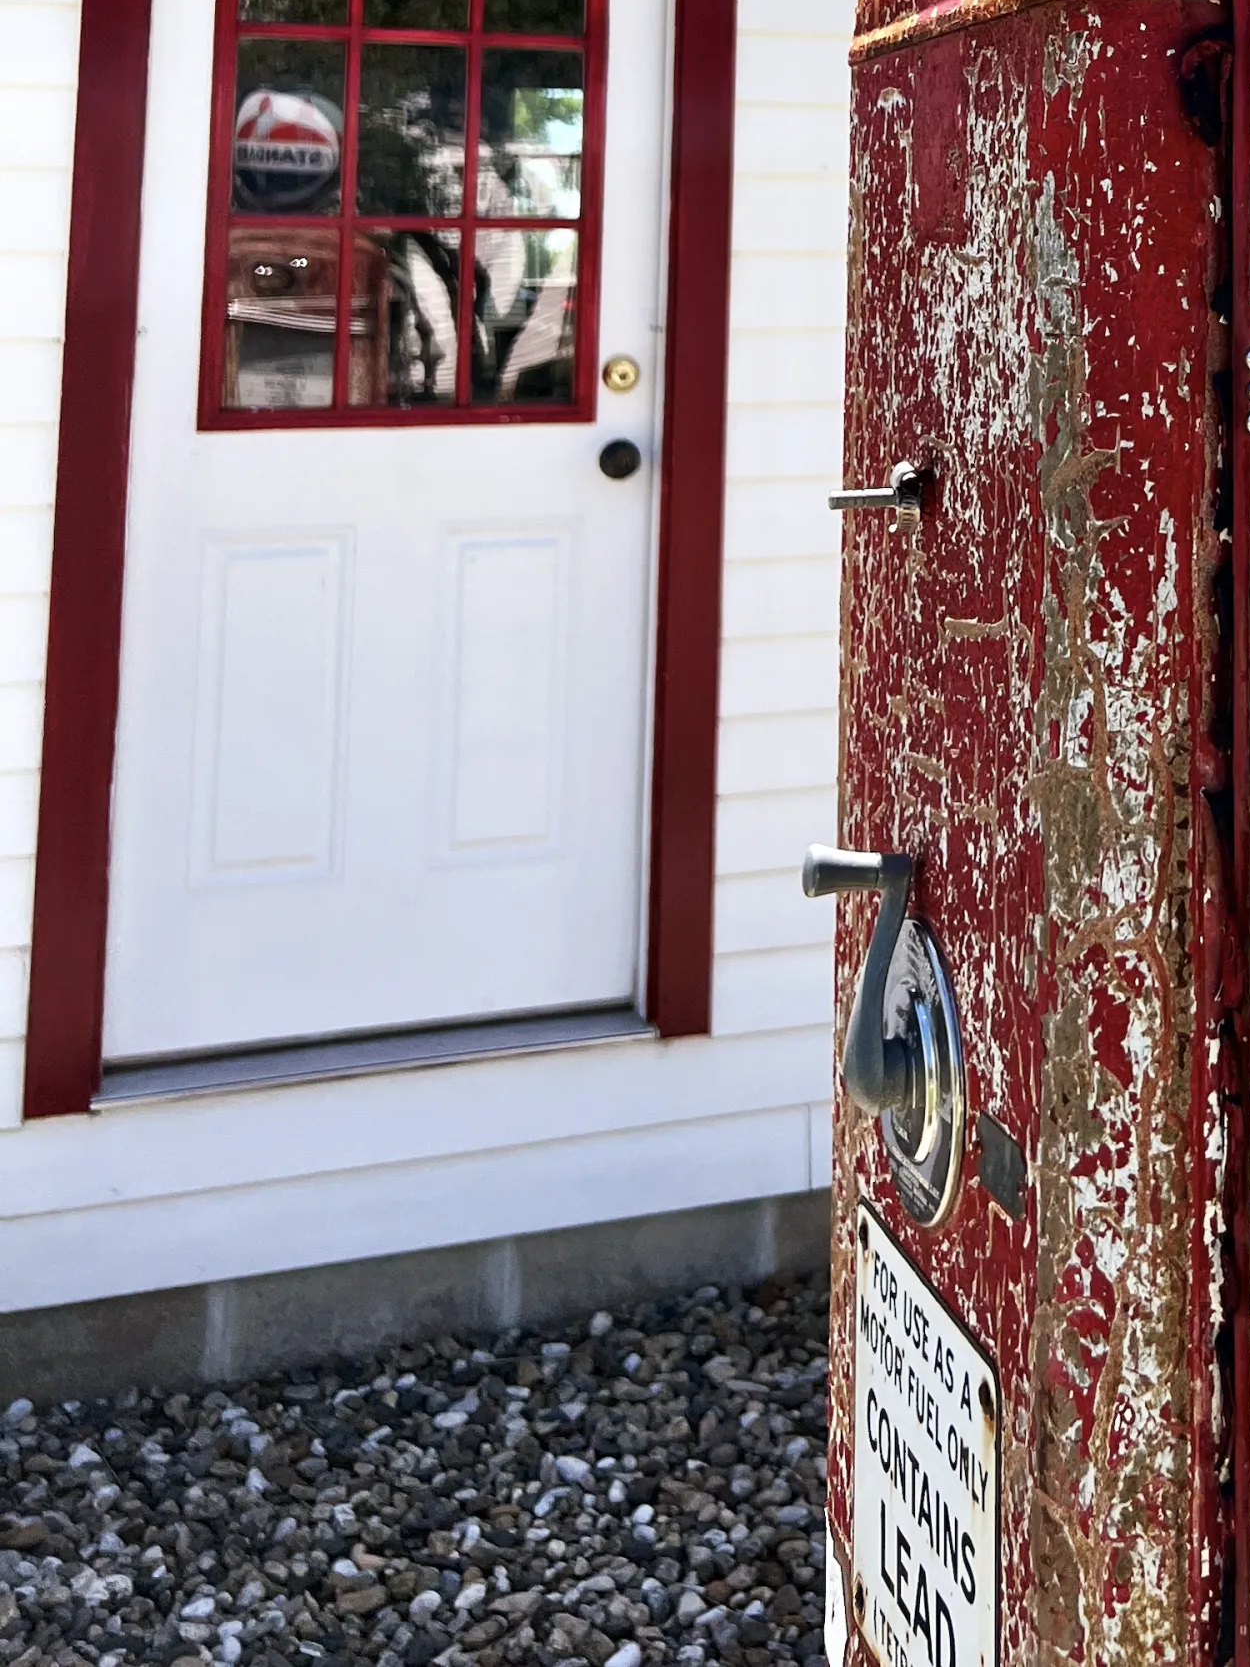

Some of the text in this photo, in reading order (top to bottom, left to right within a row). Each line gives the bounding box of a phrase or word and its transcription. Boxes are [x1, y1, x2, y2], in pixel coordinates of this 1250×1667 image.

[860, 1294, 989, 1513] MOTOR FUEL ONLY
[873, 1251, 973, 1423] FOR USE AS A
[866, 1387, 977, 1606] CONTAINS
[880, 1498, 957, 1667] LEAD
